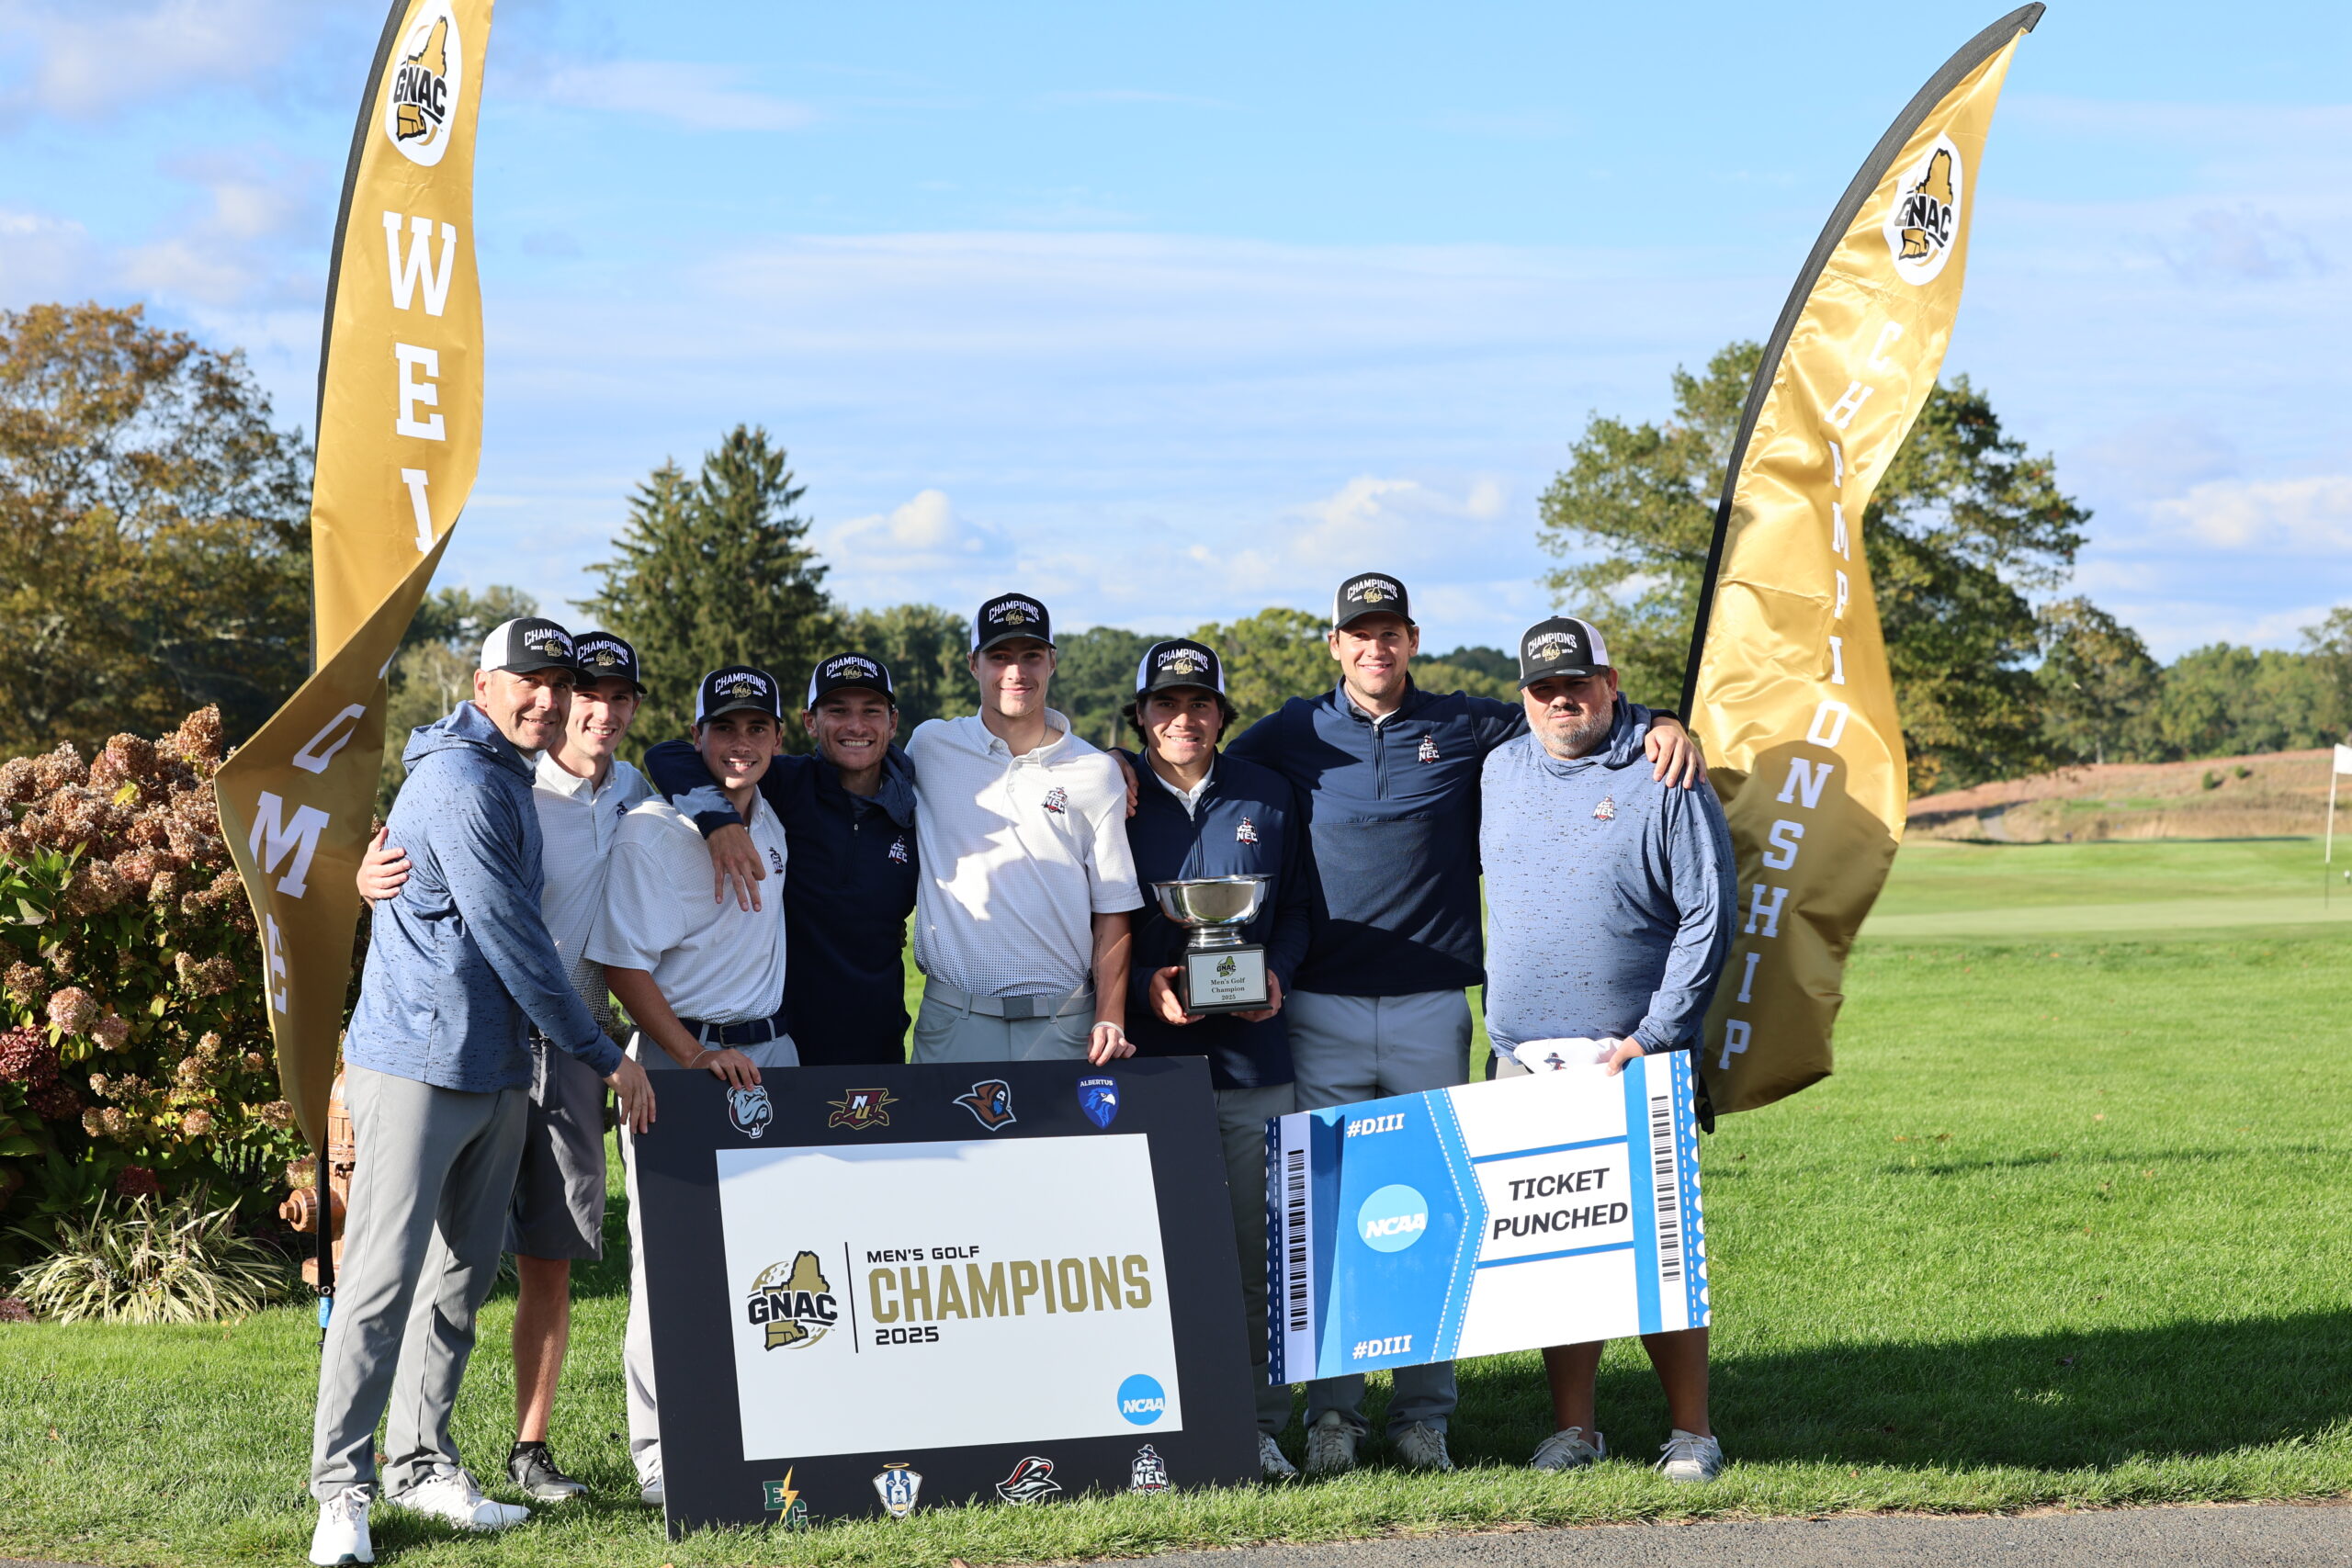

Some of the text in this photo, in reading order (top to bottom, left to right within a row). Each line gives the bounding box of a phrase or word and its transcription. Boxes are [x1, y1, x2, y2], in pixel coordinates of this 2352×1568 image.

[393, 66, 447, 118] GNAC
[1894, 195, 1952, 242] GNAC
[1347, 579, 1398, 601] CHAMPIONS
[989, 600, 1040, 622] CHAMPIONS
[524, 628, 574, 656] CHAMPIONS
[578, 640, 629, 664] CHAMPIONS
[1527, 632, 1577, 657] CHAMPIONS
[826, 656, 878, 678] CHAMPIONS
[1158, 649, 1208, 670] CHAMPIONS
[715, 671, 767, 694] CHAMPIONS
[1418, 750, 1440, 761] NEC
[1042, 796, 1066, 812] NEC
[1236, 831, 1258, 841] NEC
[888, 850, 908, 863] NEC
[1211, 986, 1245, 994] Champion
[1080, 1078, 1114, 1087] ALBERTUS
[1346, 1112, 1406, 1138] #DIII
[1508, 1168, 1611, 1201] TICKET
[1364, 1213, 1427, 1239] NCAA
[1492, 1201, 1629, 1240] PUNCHED
[866, 1246, 980, 1263] MEN'S GOLF
[868, 1254, 1153, 1324] CHAMPIONS
[748, 1292, 838, 1325] GNAC
[875, 1325, 940, 1346] 2025
[1351, 1334, 1413, 1360] #DIII
[1123, 1397, 1165, 1415] NCAA
[1132, 1471, 1168, 1489] NEC
